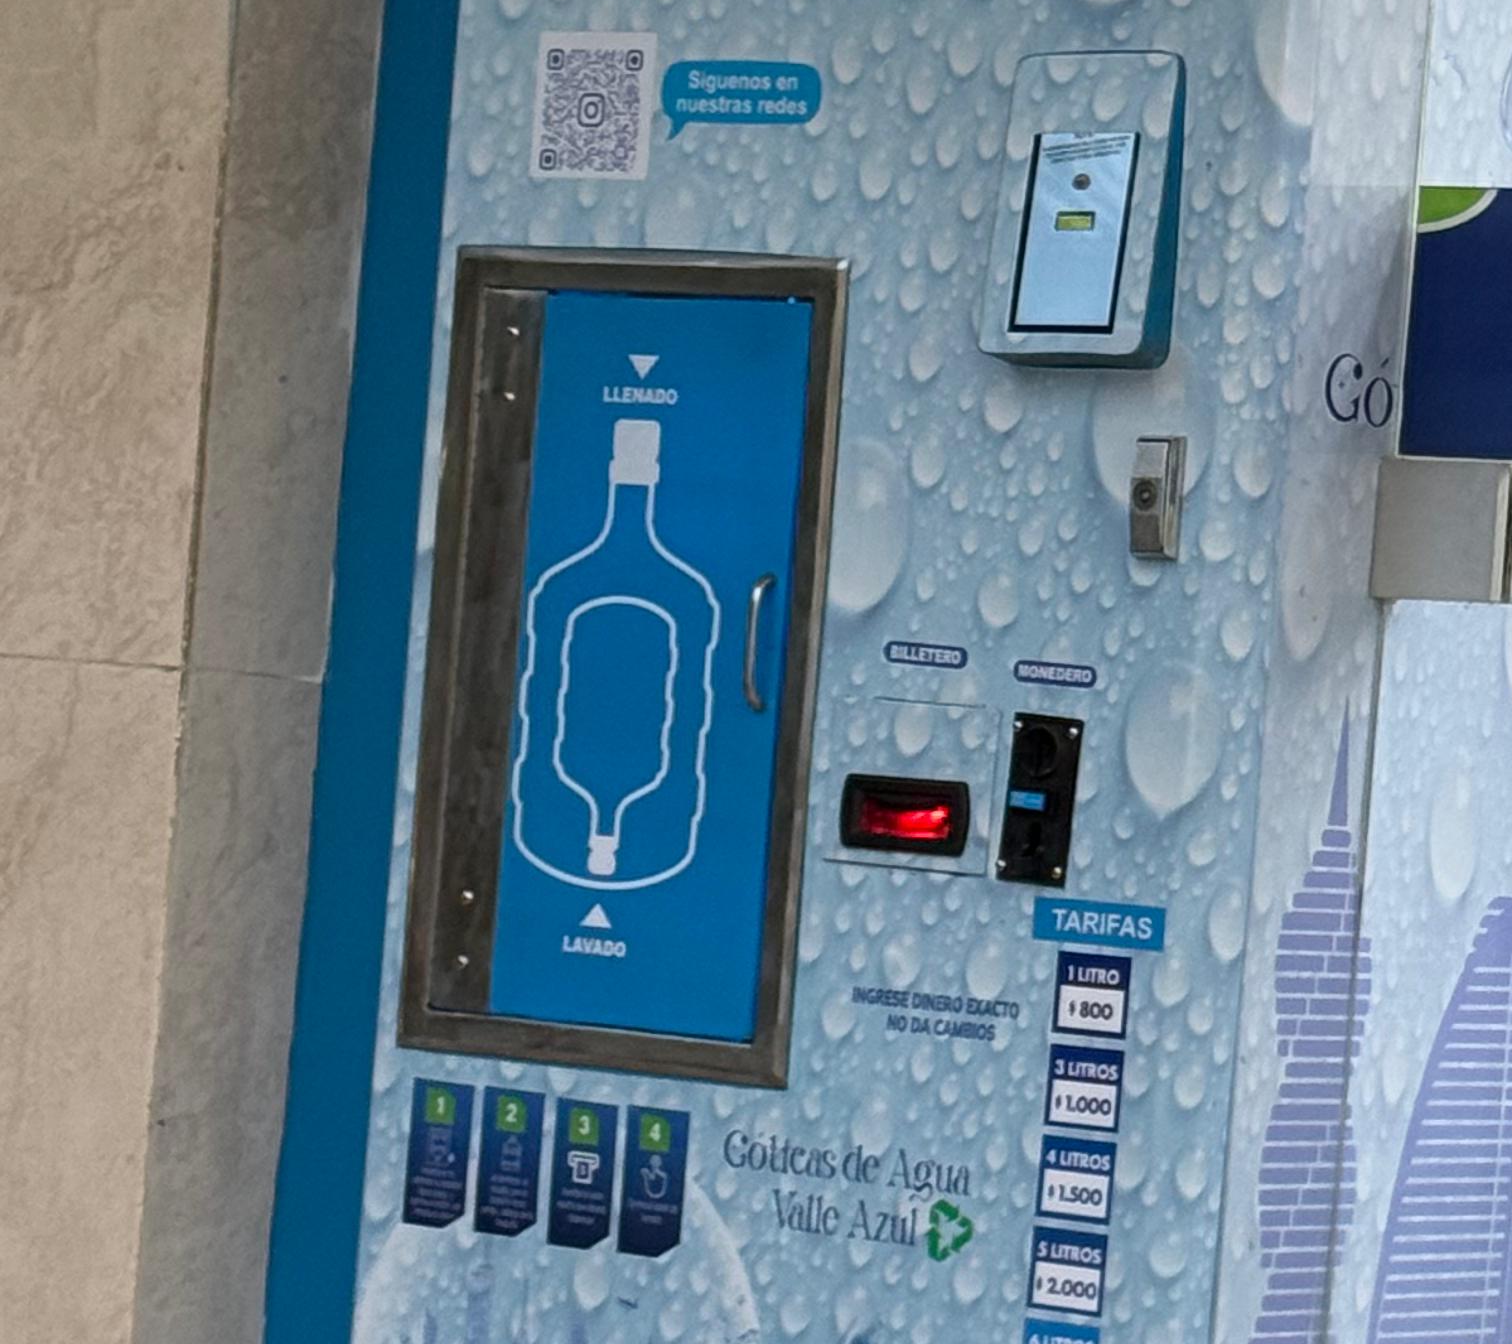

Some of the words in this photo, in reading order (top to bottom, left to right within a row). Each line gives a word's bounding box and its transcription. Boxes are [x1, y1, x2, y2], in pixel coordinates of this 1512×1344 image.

[776, 76, 799, 91] en
[675, 97, 751, 114] nuestras
[756, 97, 808, 115] redes
[602, 385, 679, 405] LLENADO
[889, 644, 962, 665] BILLETERO
[1018, 663, 1093, 683] MONEDERO
[1051, 908, 1153, 940] TARIFAS
[562, 935, 627, 958] LAVADO
[1067, 965, 1074, 982] 1
[1077, 967, 1120, 986] LITRO
[852, 986, 910, 1008] INGRESE
[911, 992, 963, 1014] DINERO
[966, 998, 1020, 1020] EXACTO
[1079, 1000, 1114, 1020] 800
[886, 1013, 906, 1032] NO
[910, 1017, 931, 1035] DA
[934, 1019, 997, 1042] CAMBIOS
[1054, 1058, 1064, 1076] 3
[1067, 1061, 1119, 1081] LITROS
[436, 1096, 446, 1114] 1
[505, 1102, 518, 1124] 2
[578, 1115, 591, 1136] 3
[649, 1122, 662, 1142] 4
[1046, 1149, 1056, 1164] 4
[1059, 1150, 1111, 1171] LITROS
[842, 1144, 880, 1184] de
[886, 1148, 971, 1202] Agua
[772, 1188, 841, 1236] Valle
[847, 1199, 918, 1246] Azul
[1037, 1240, 1048, 1257] 5
[1050, 1242, 1101, 1265] LITROS
